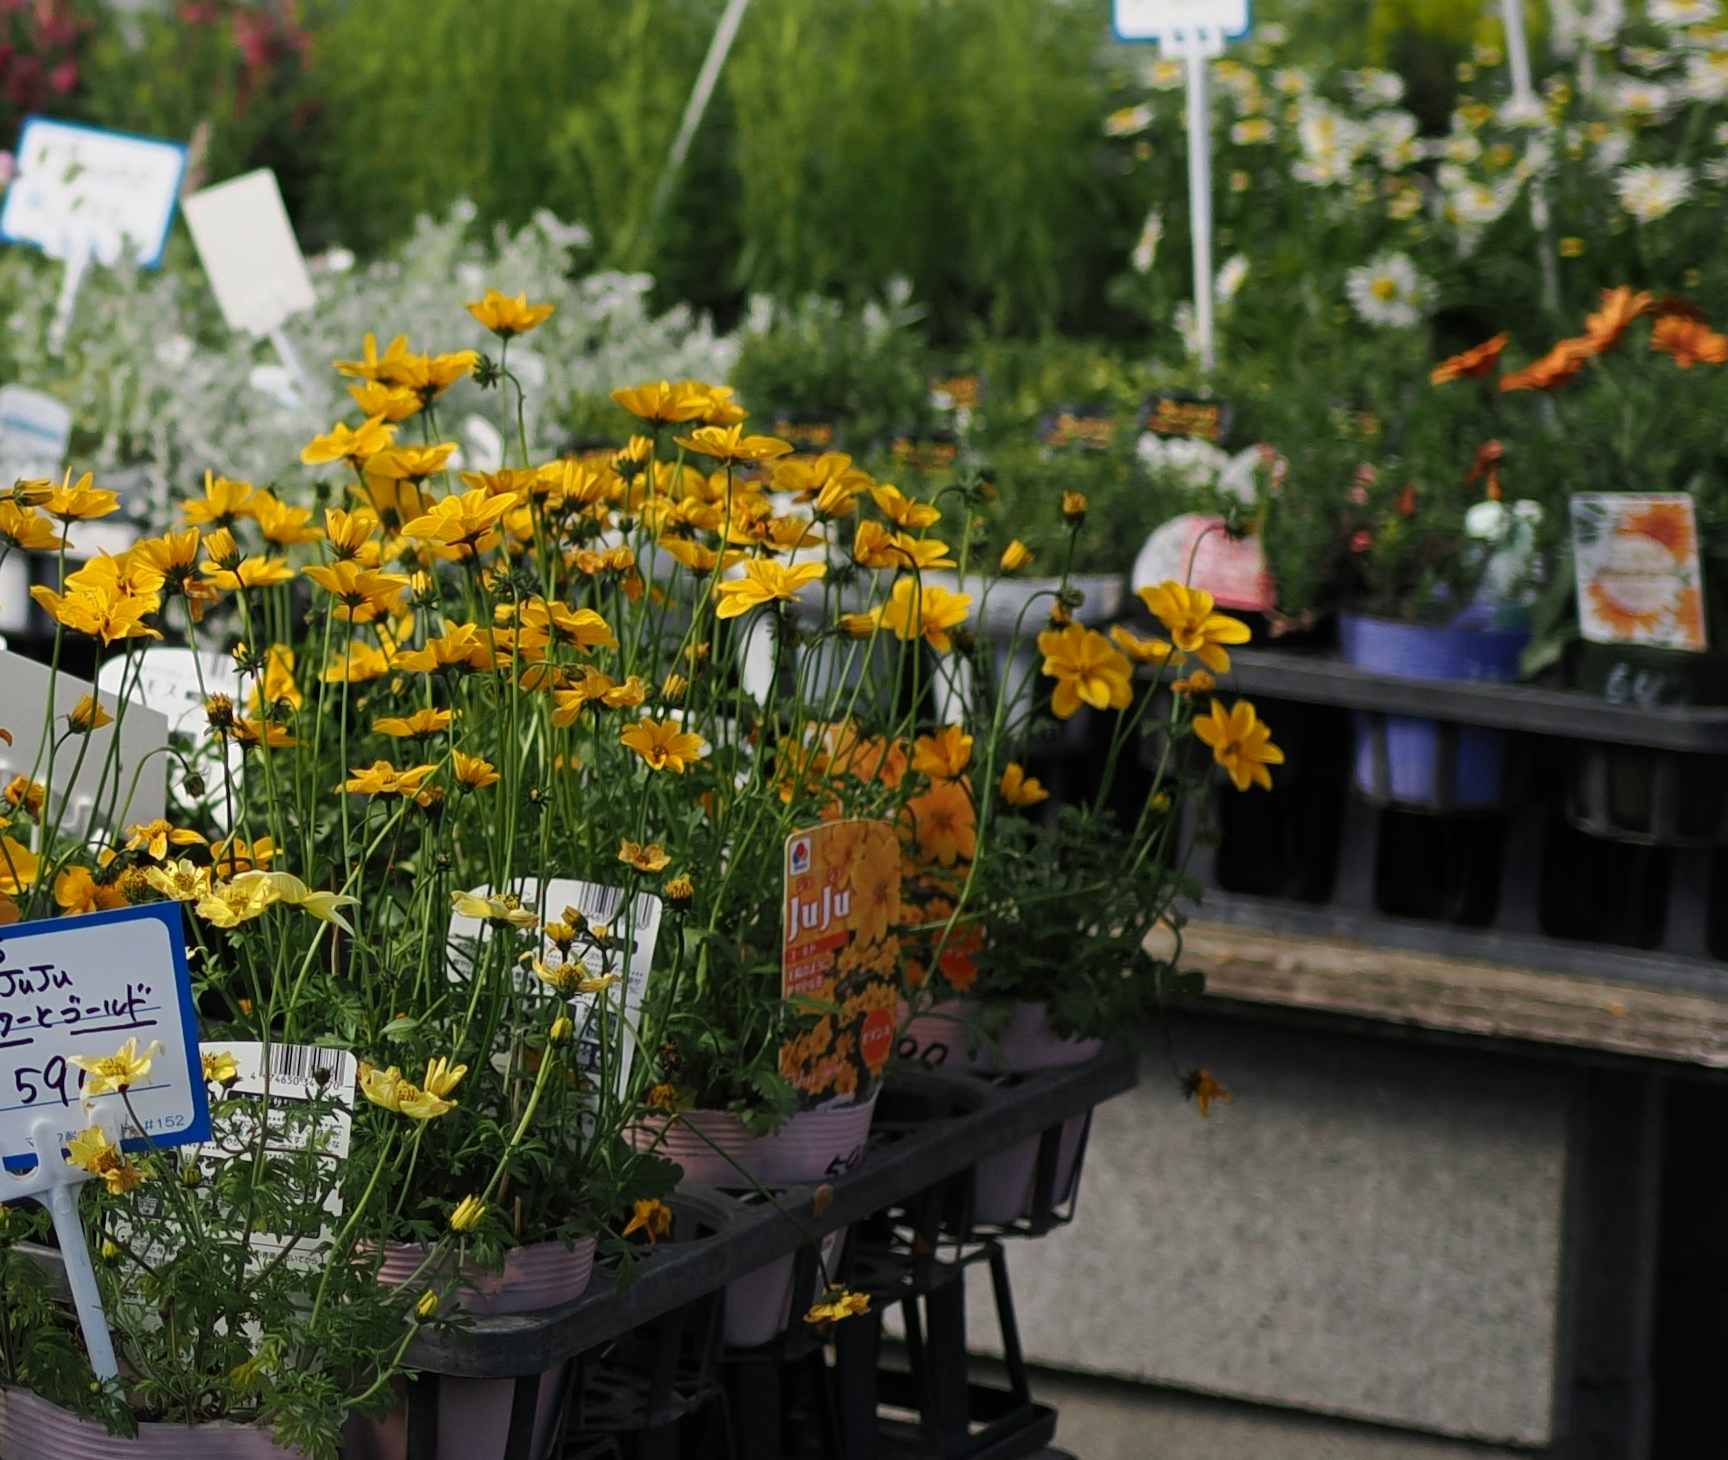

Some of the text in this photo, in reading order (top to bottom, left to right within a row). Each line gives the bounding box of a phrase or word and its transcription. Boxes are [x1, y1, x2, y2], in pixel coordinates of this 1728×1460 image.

[788, 886, 851, 943] JuJu
[15, 1055, 86, 1107] 59
[144, 1114, 185, 1130] #152
